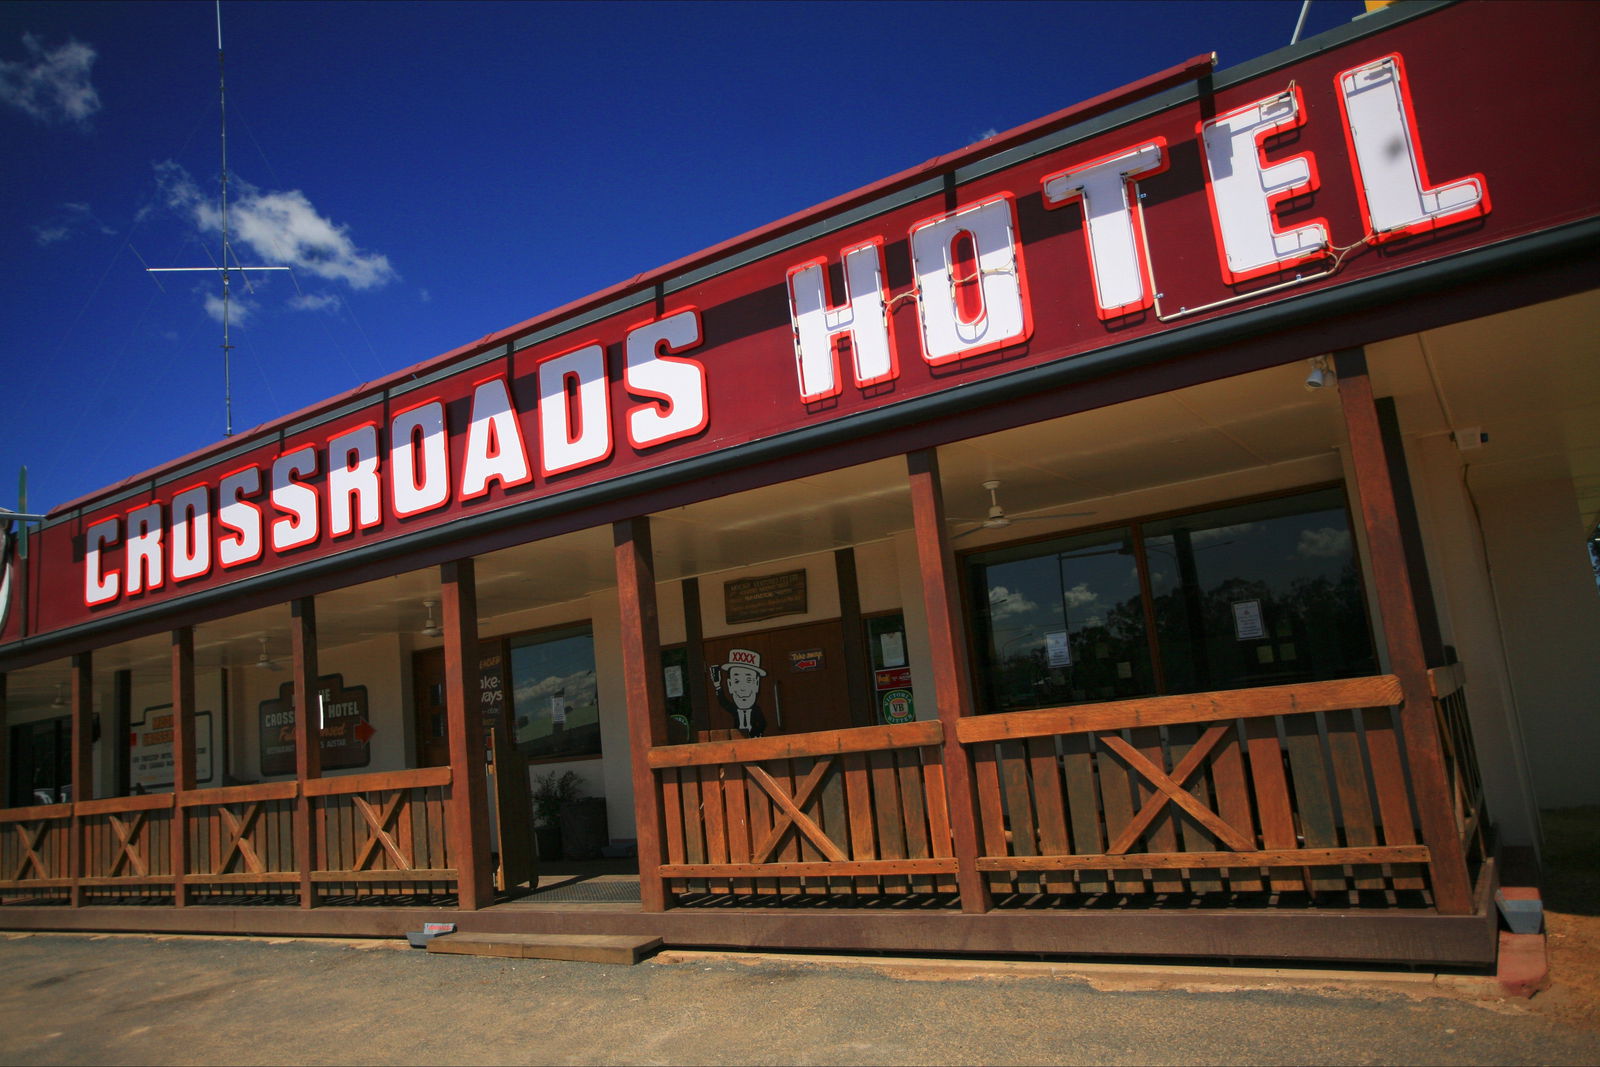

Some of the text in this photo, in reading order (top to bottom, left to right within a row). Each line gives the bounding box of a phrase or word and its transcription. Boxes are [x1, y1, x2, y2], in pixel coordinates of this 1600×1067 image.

[85, 53, 1491, 606] CROSSROADS HOTEL
[733, 652, 756, 664] XXXX
[884, 691, 913, 706] VICTORIA
[327, 700, 359, 718] HOTEL
[893, 703, 905, 712] VB
[887, 713, 914, 724] BITTER
